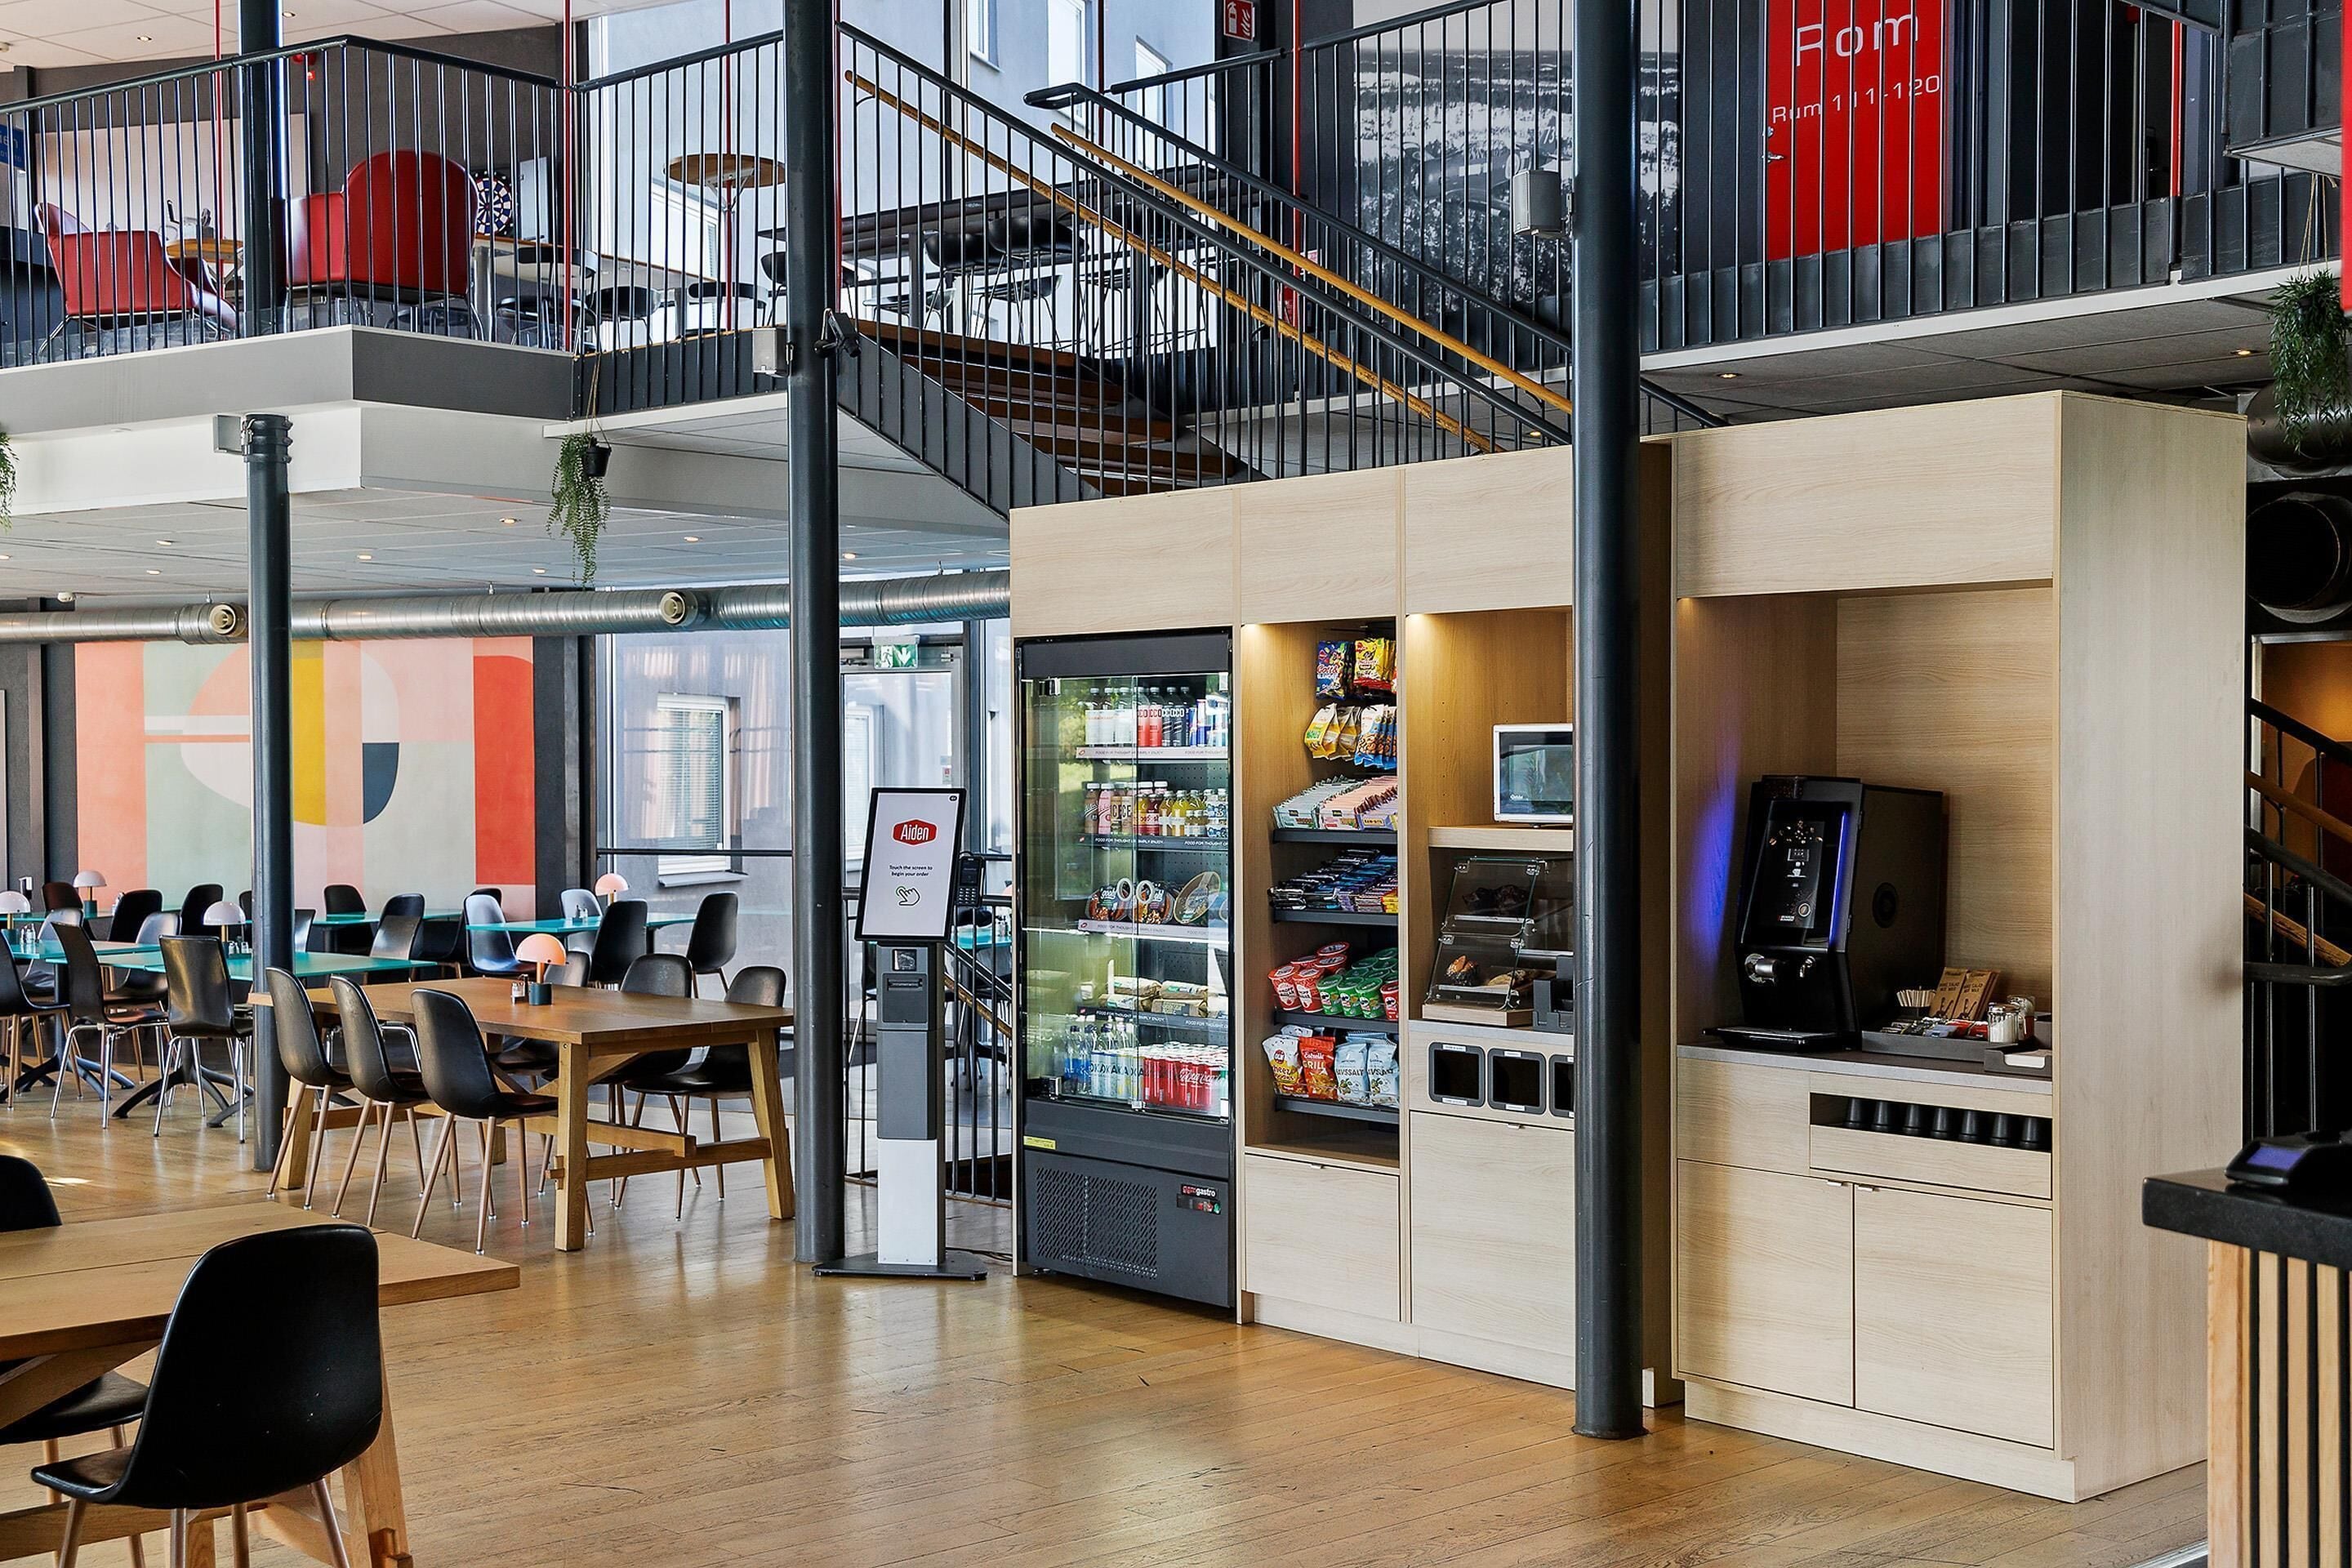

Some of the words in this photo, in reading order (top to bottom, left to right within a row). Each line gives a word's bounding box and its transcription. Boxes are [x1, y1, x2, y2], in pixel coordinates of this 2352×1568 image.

[1796, 14, 1918, 67] Rom
[1772, 103, 1821, 123] Rum
[1832, 75, 1940, 112] 111-120
[900, 824, 929, 840] Aiden
